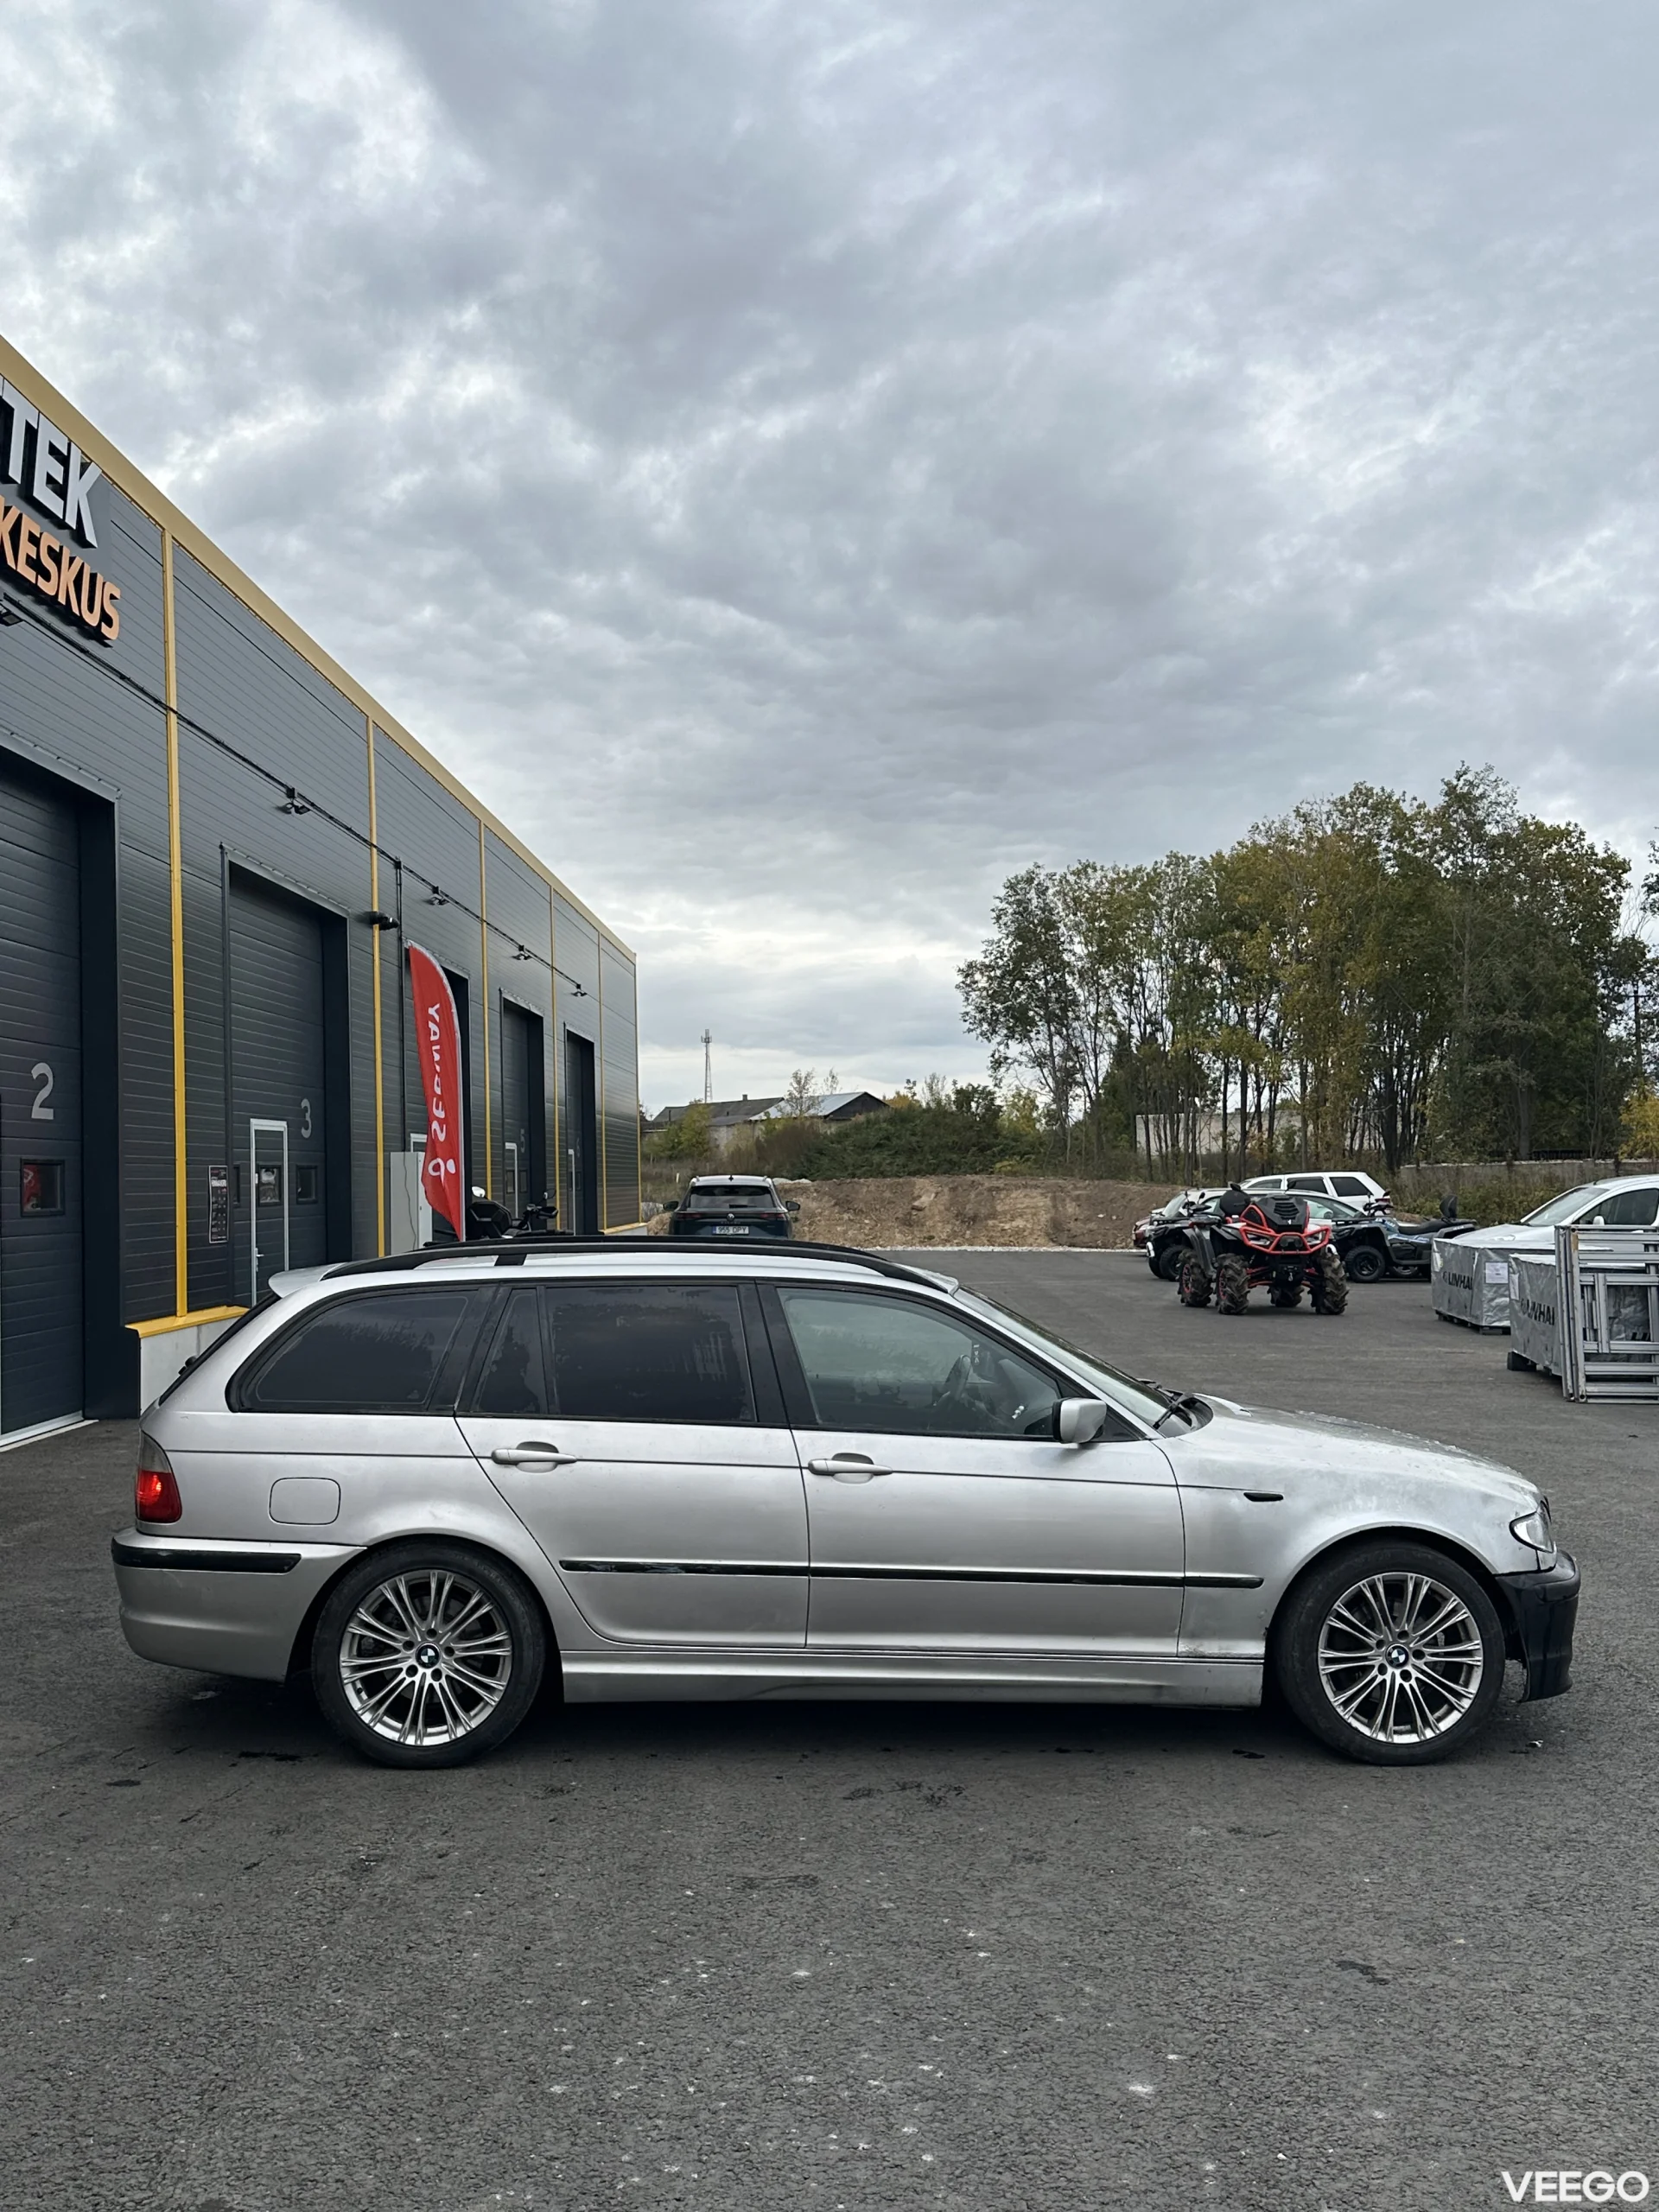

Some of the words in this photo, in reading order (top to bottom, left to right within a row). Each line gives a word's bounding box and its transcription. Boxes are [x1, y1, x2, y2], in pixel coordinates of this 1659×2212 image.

[0, 374, 102, 548] TEK
[0, 495, 120, 640] KESKUS
[31, 1062, 54, 1120] 2
[302, 1098, 311, 1138] 3
